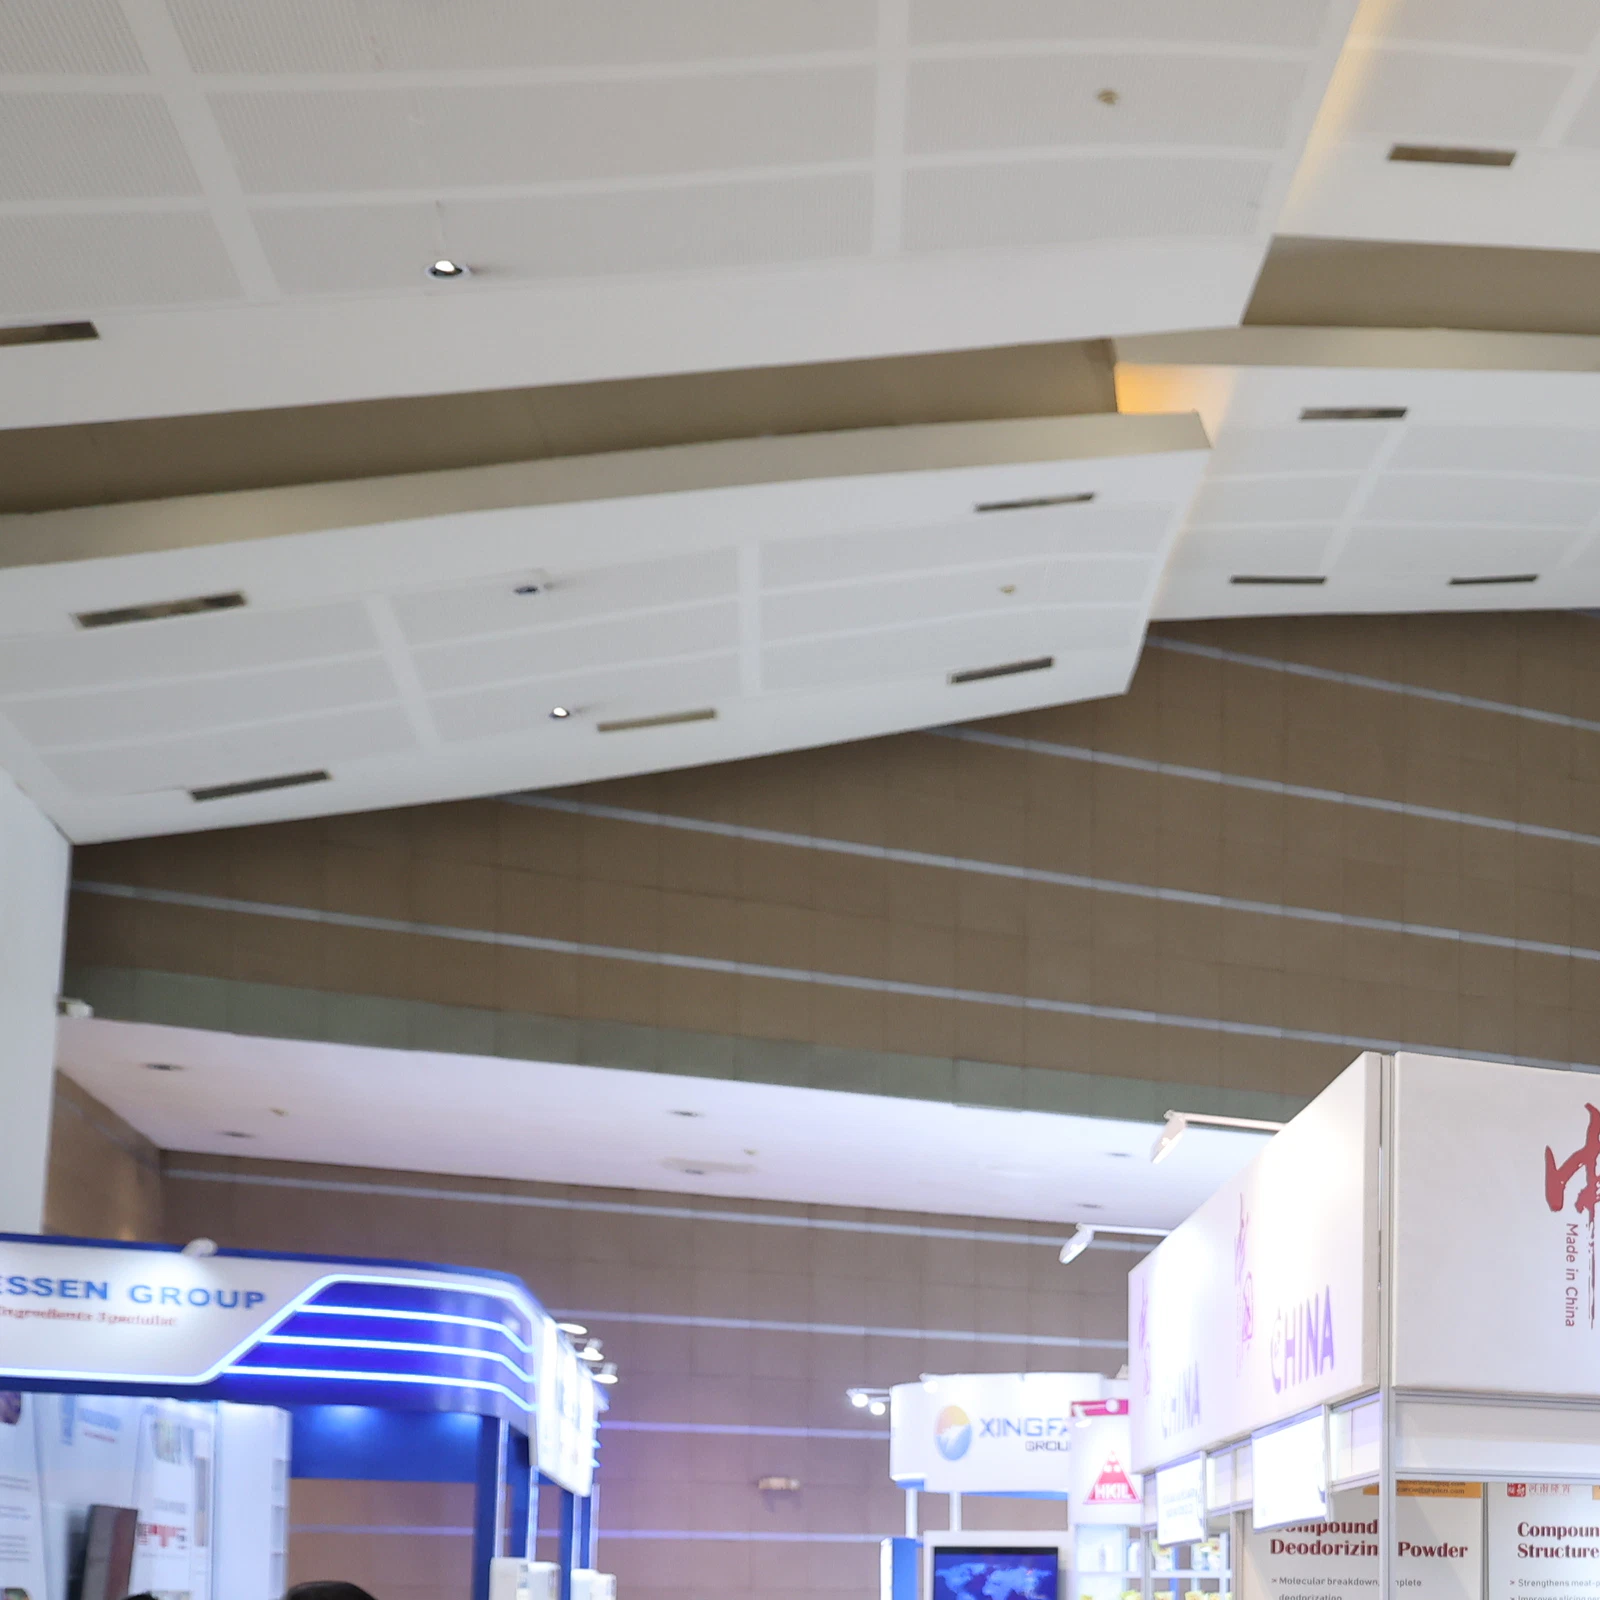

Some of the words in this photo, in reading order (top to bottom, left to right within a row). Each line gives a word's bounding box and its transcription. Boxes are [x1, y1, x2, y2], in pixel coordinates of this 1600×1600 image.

[1566, 1222, 1578, 1263] Made
[1566, 1269, 1578, 1281] in
[0, 1275, 109, 1301] SSEN
[128, 1284, 266, 1309] GROUP
[1565, 1287, 1578, 1327] China
[1270, 1284, 1335, 1395] CHINA
[1025, 1440, 1070, 1452] GROU
[1094, 1484, 1132, 1500] HKIL
[1276, 1519, 1379, 1537] mpound
[1270, 1539, 1379, 1557] Deodorizin
[1398, 1541, 1468, 1558] Powder
[1517, 1543, 1600, 1559] Structure
[1279, 1576, 1326, 1586] Molecular
[1518, 1578, 1569, 1589] Strengthens
